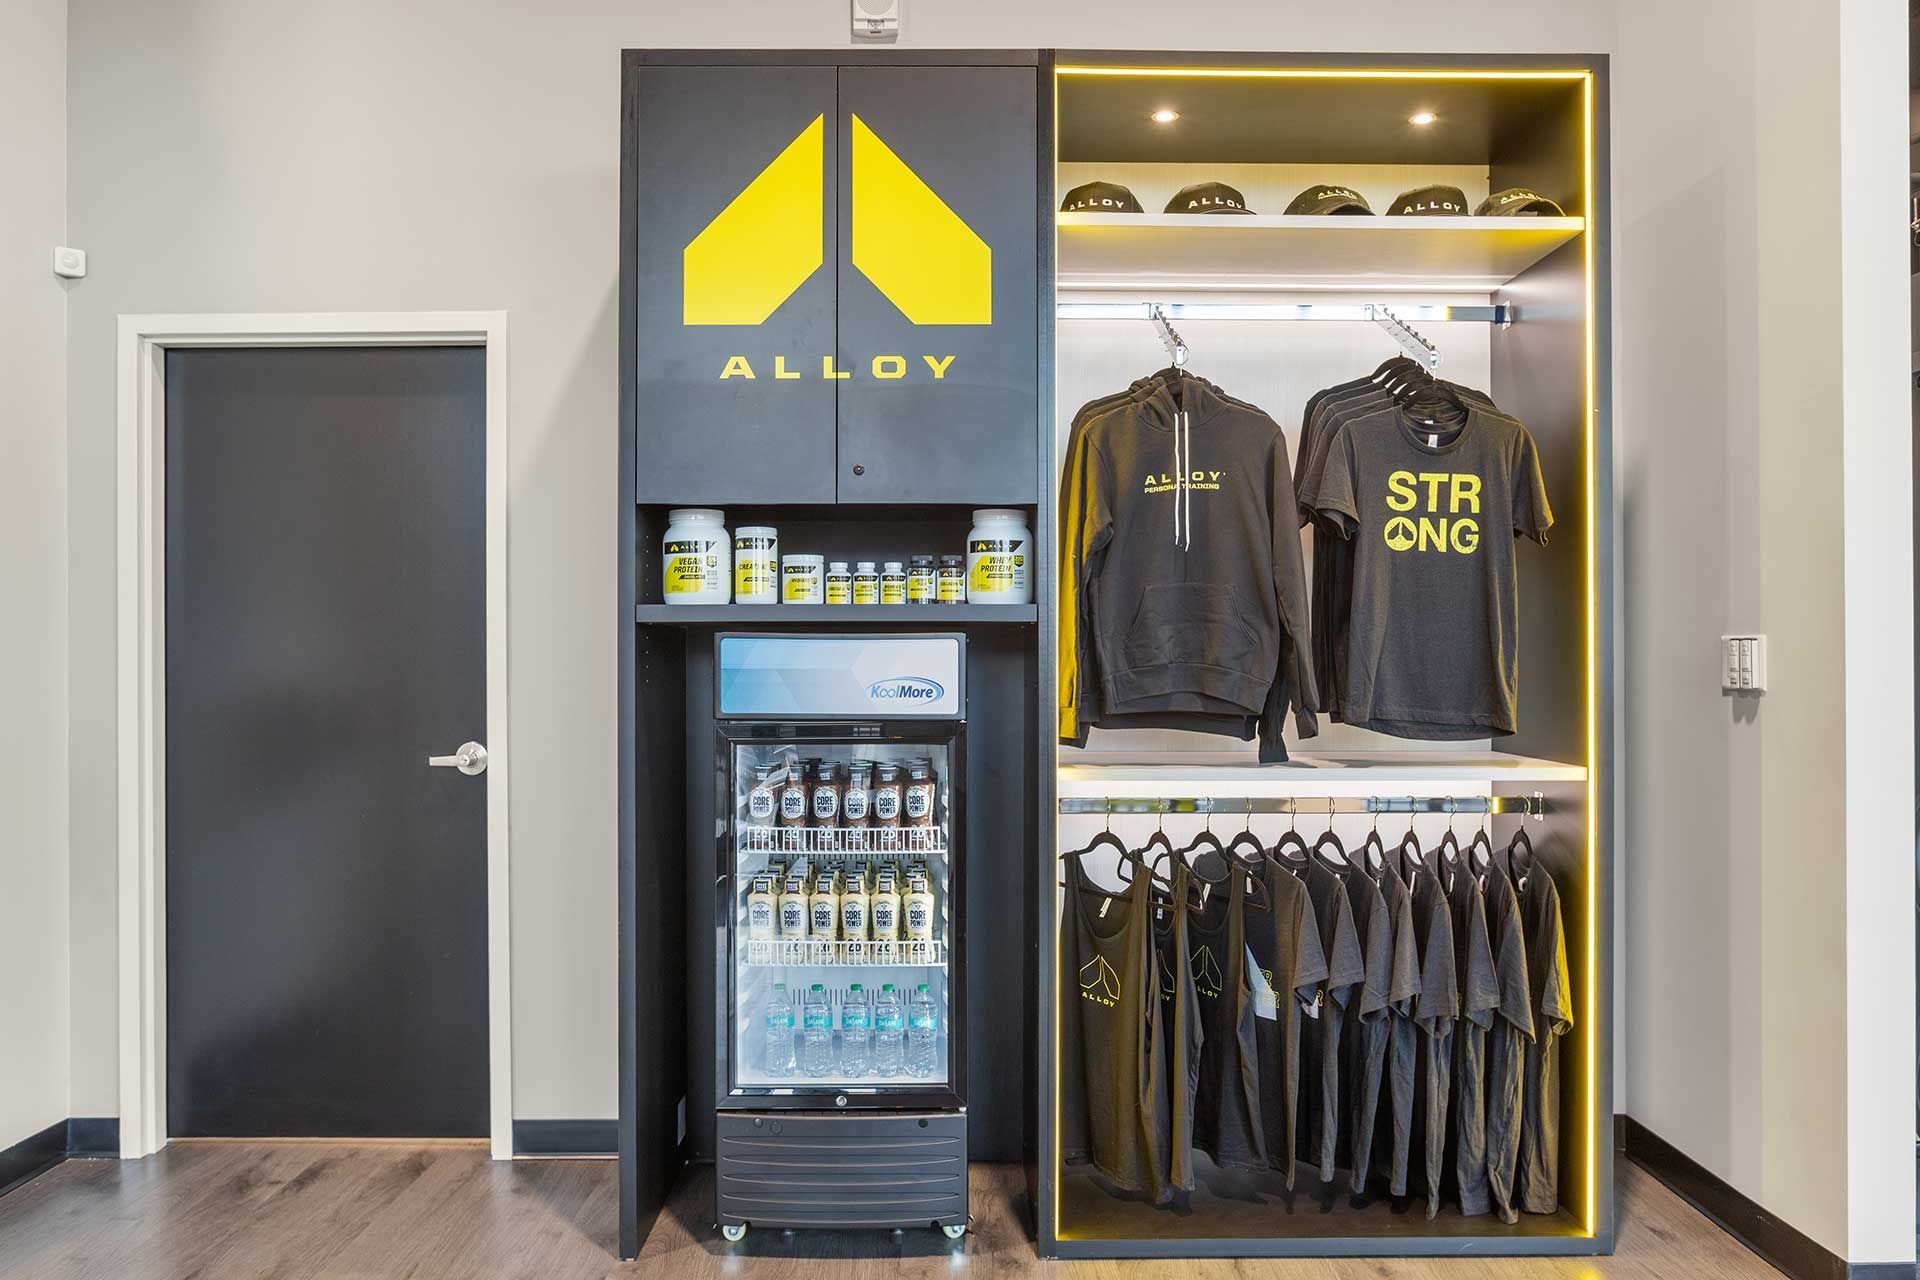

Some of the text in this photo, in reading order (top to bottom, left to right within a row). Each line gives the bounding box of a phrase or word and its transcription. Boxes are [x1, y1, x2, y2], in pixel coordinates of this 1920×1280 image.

[1069, 198, 1125, 212] ALLOY
[1188, 196, 1242, 209] ALLOY
[1403, 201, 1461, 215] ALLOY
[719, 355, 956, 379] ALLOY
[1144, 471, 1221, 486] ALLOY
[1144, 483, 1181, 494] PERSONA
[1386, 470, 1482, 514] STR
[679, 556, 703, 566] VEGAN
[990, 556, 1012, 564] WHEY
[673, 565, 703, 574] PROTEIN
[981, 564, 1012, 573] PROTEIN
[870, 684, 934, 698] KoolMore
[752, 796, 770, 806] CORE
[784, 797, 801, 807] CORE
[816, 796, 833, 806] CORE
[847, 798, 864, 807] CORE
[878, 797, 896, 807] CORE
[908, 796, 924, 805] CORE
[847, 807, 864, 815] POWER
[909, 805, 925, 813] POWER
[752, 910, 770, 920] CORE
[783, 910, 801, 920] CORE
[814, 910, 831, 920] CORE
[845, 910, 862, 920] CORE
[876, 910, 893, 920] CORE
[910, 910, 926, 920] CORE
[784, 919, 801, 928] POWER
[814, 919, 832, 928] POWER
[845, 919, 862, 928] POWER
[876, 919, 893, 928] POWER
[910, 919, 926, 928] POWER
[848, 938, 862, 952] 26
[912, 938, 926, 952] 26
[1196, 985, 1218, 998] LLOY
[1081, 992, 1116, 1008] ALLOY
